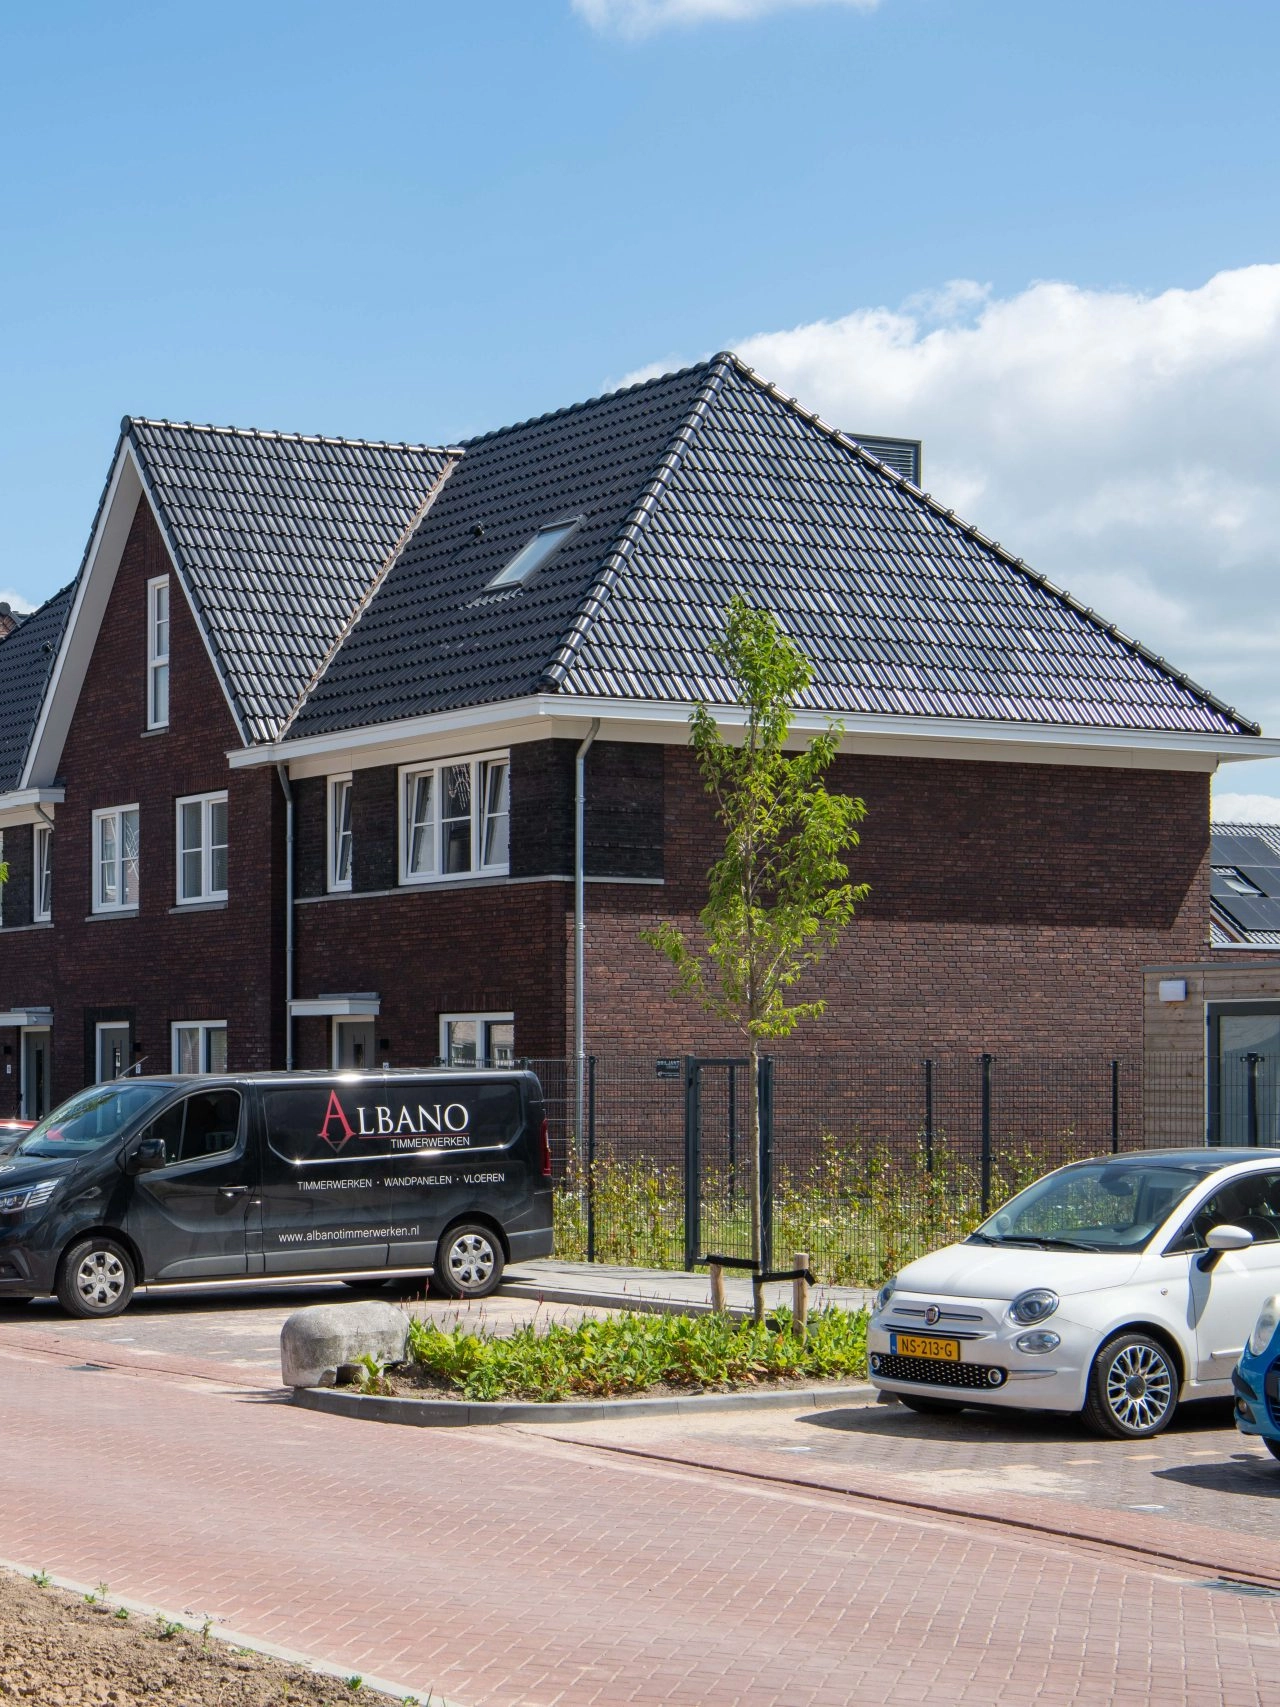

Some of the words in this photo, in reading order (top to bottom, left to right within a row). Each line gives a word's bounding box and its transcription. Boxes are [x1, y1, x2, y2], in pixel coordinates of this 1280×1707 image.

[317, 1089, 470, 1137] ALBANO
[391, 1136, 470, 1149] TIMMERWERKEN
[297, 1178, 372, 1191] TIMMERWERKEN
[383, 1175, 452, 1187] WANDPANELEN
[463, 1173, 505, 1184] VLOEREN
[278, 1225, 420, 1243] www.albanotimmerwerken.nl
[901, 1337, 952, 1357] NS-213-G
